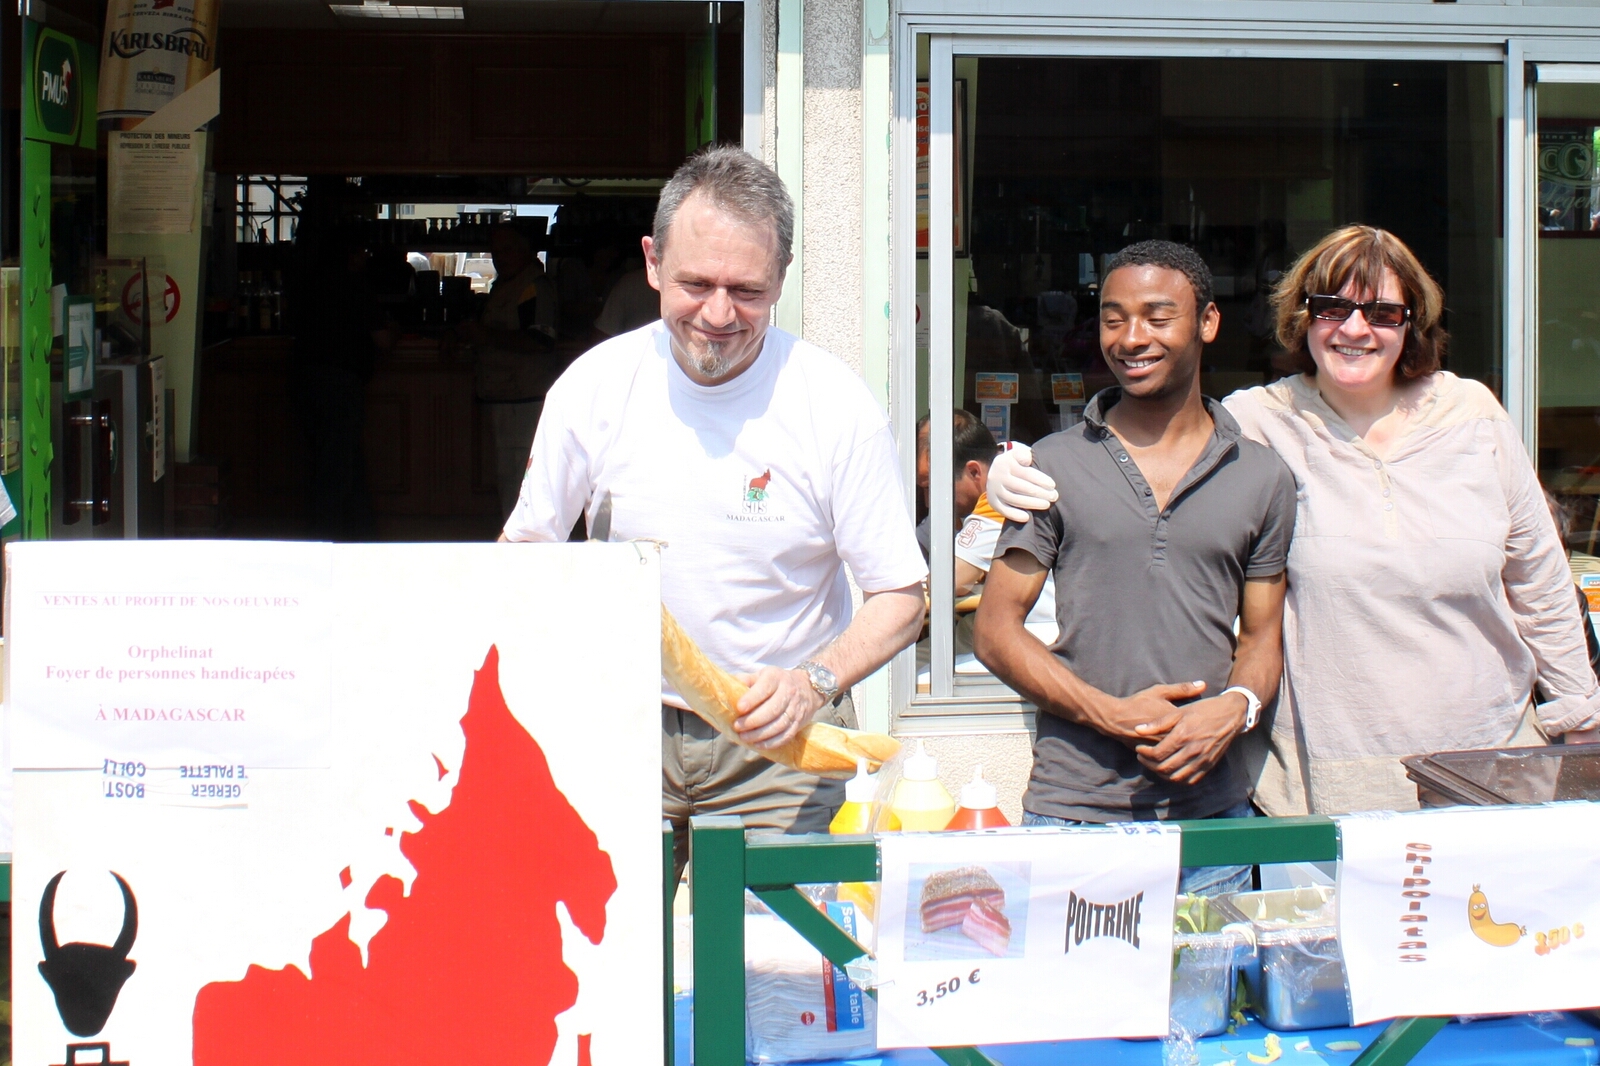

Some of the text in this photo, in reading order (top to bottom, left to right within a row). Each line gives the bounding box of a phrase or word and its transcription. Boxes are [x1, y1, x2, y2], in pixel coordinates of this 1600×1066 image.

[41, 70, 63, 104] PMU
[726, 514, 785, 522] MADAGASCAR
[43, 595, 300, 608] VENTES AU PROFIT DE NOS OEUVRES
[127, 645, 213, 662] Orphelinat
[45, 665, 296, 684] Foyer de personnes handicapées
[94, 704, 246, 722] À MADAGASCAR
[179, 765, 234, 779] PALETTE
[191, 784, 242, 798] GERBER
[1064, 890, 1144, 955] POITRINE
[916, 968, 981, 1007] 3,50 €
[849, 993, 861, 1024] table
